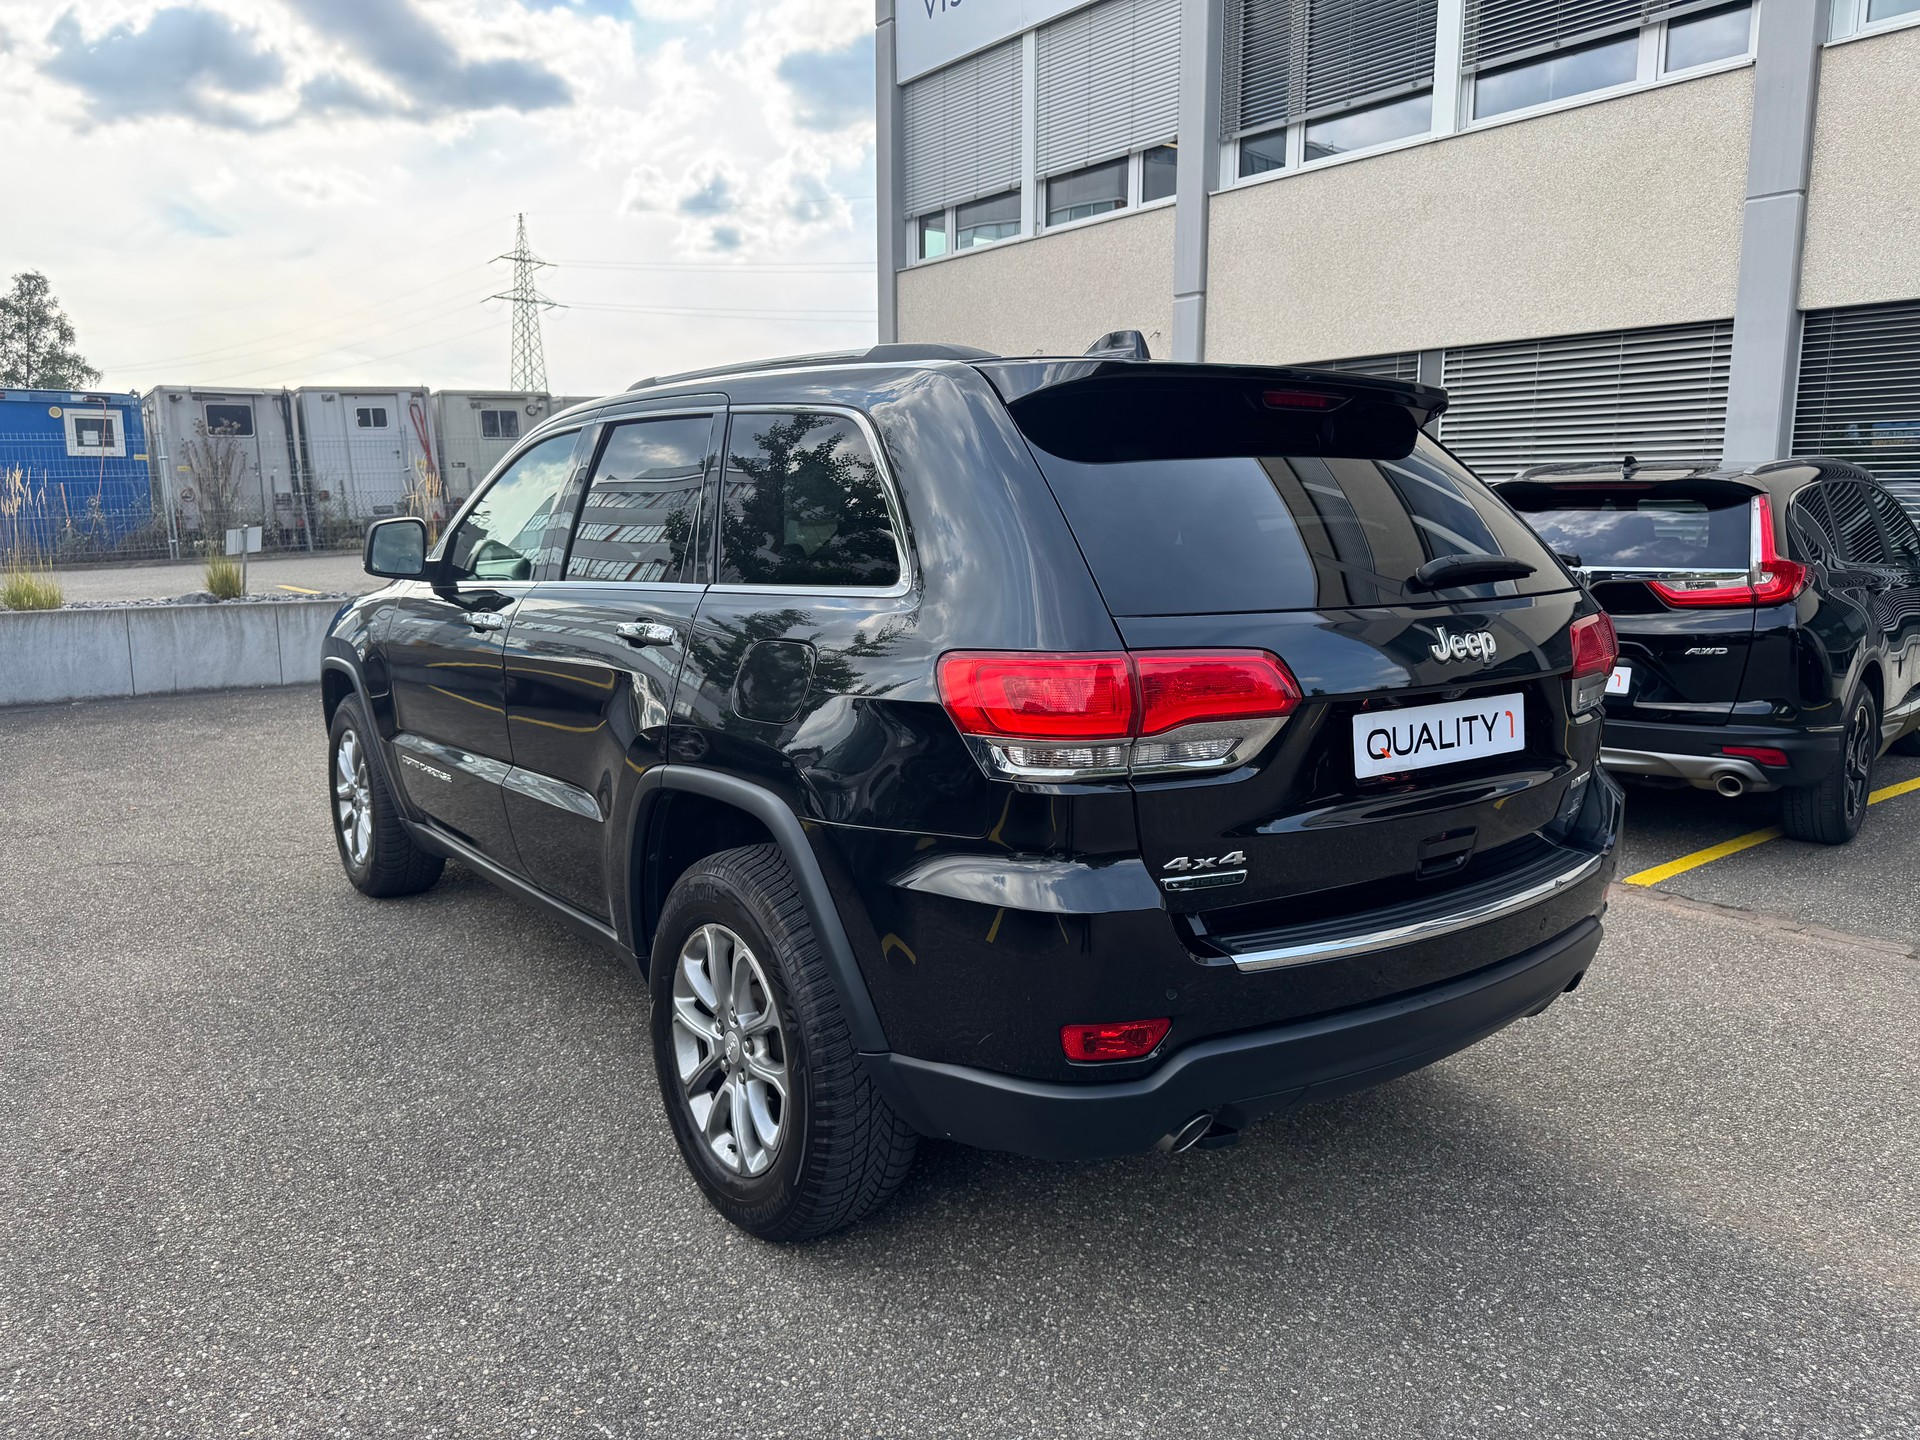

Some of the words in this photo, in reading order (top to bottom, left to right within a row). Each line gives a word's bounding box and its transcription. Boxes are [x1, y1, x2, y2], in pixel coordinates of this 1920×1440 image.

[1431, 626, 1497, 664] Jeep
[1684, 647, 1729, 655] AWD
[1366, 711, 1500, 761] QUALITY
[1504, 710, 1514, 738] 1
[1162, 850, 1247, 872] 4x4
[1184, 875, 1242, 887] DIESEL
